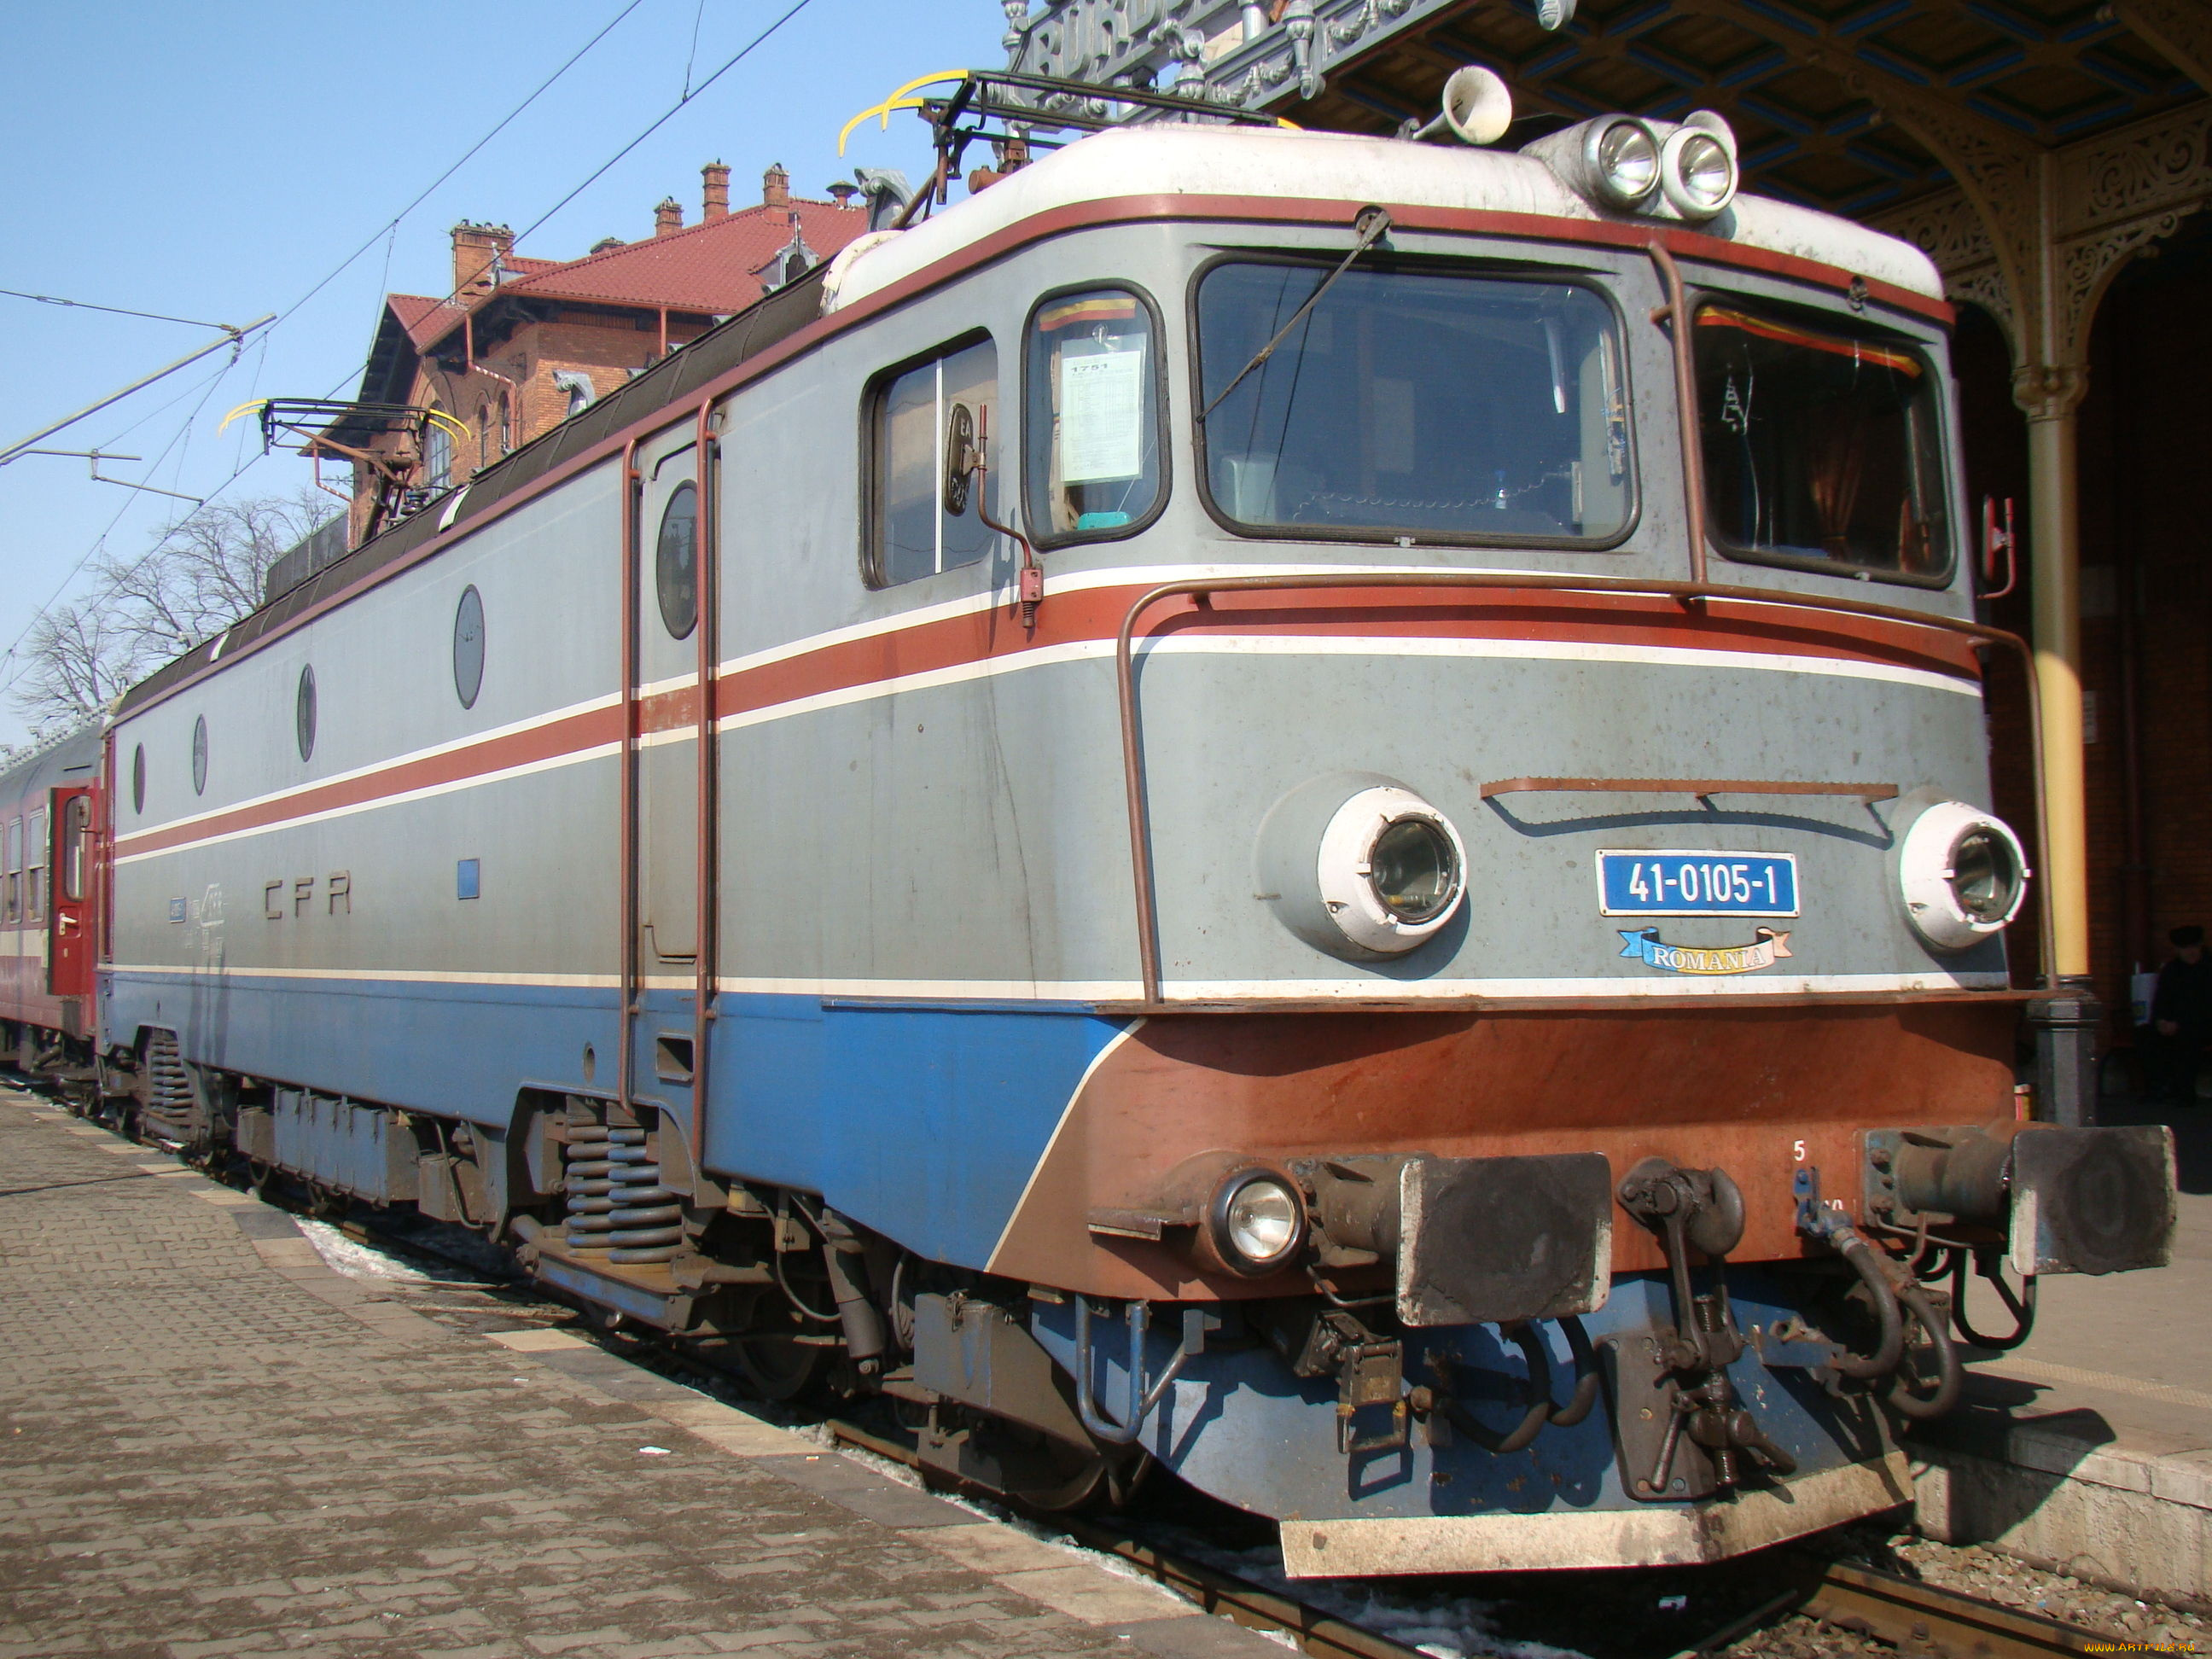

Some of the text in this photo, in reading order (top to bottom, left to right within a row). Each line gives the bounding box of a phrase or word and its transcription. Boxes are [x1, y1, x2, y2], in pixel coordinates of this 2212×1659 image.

[265, 870, 351, 919] CFR
[1629, 863, 1776, 905] 41-0105-1
[1652, 946, 1767, 971] ROMANIA
[1794, 1140, 1806, 1161] 5
